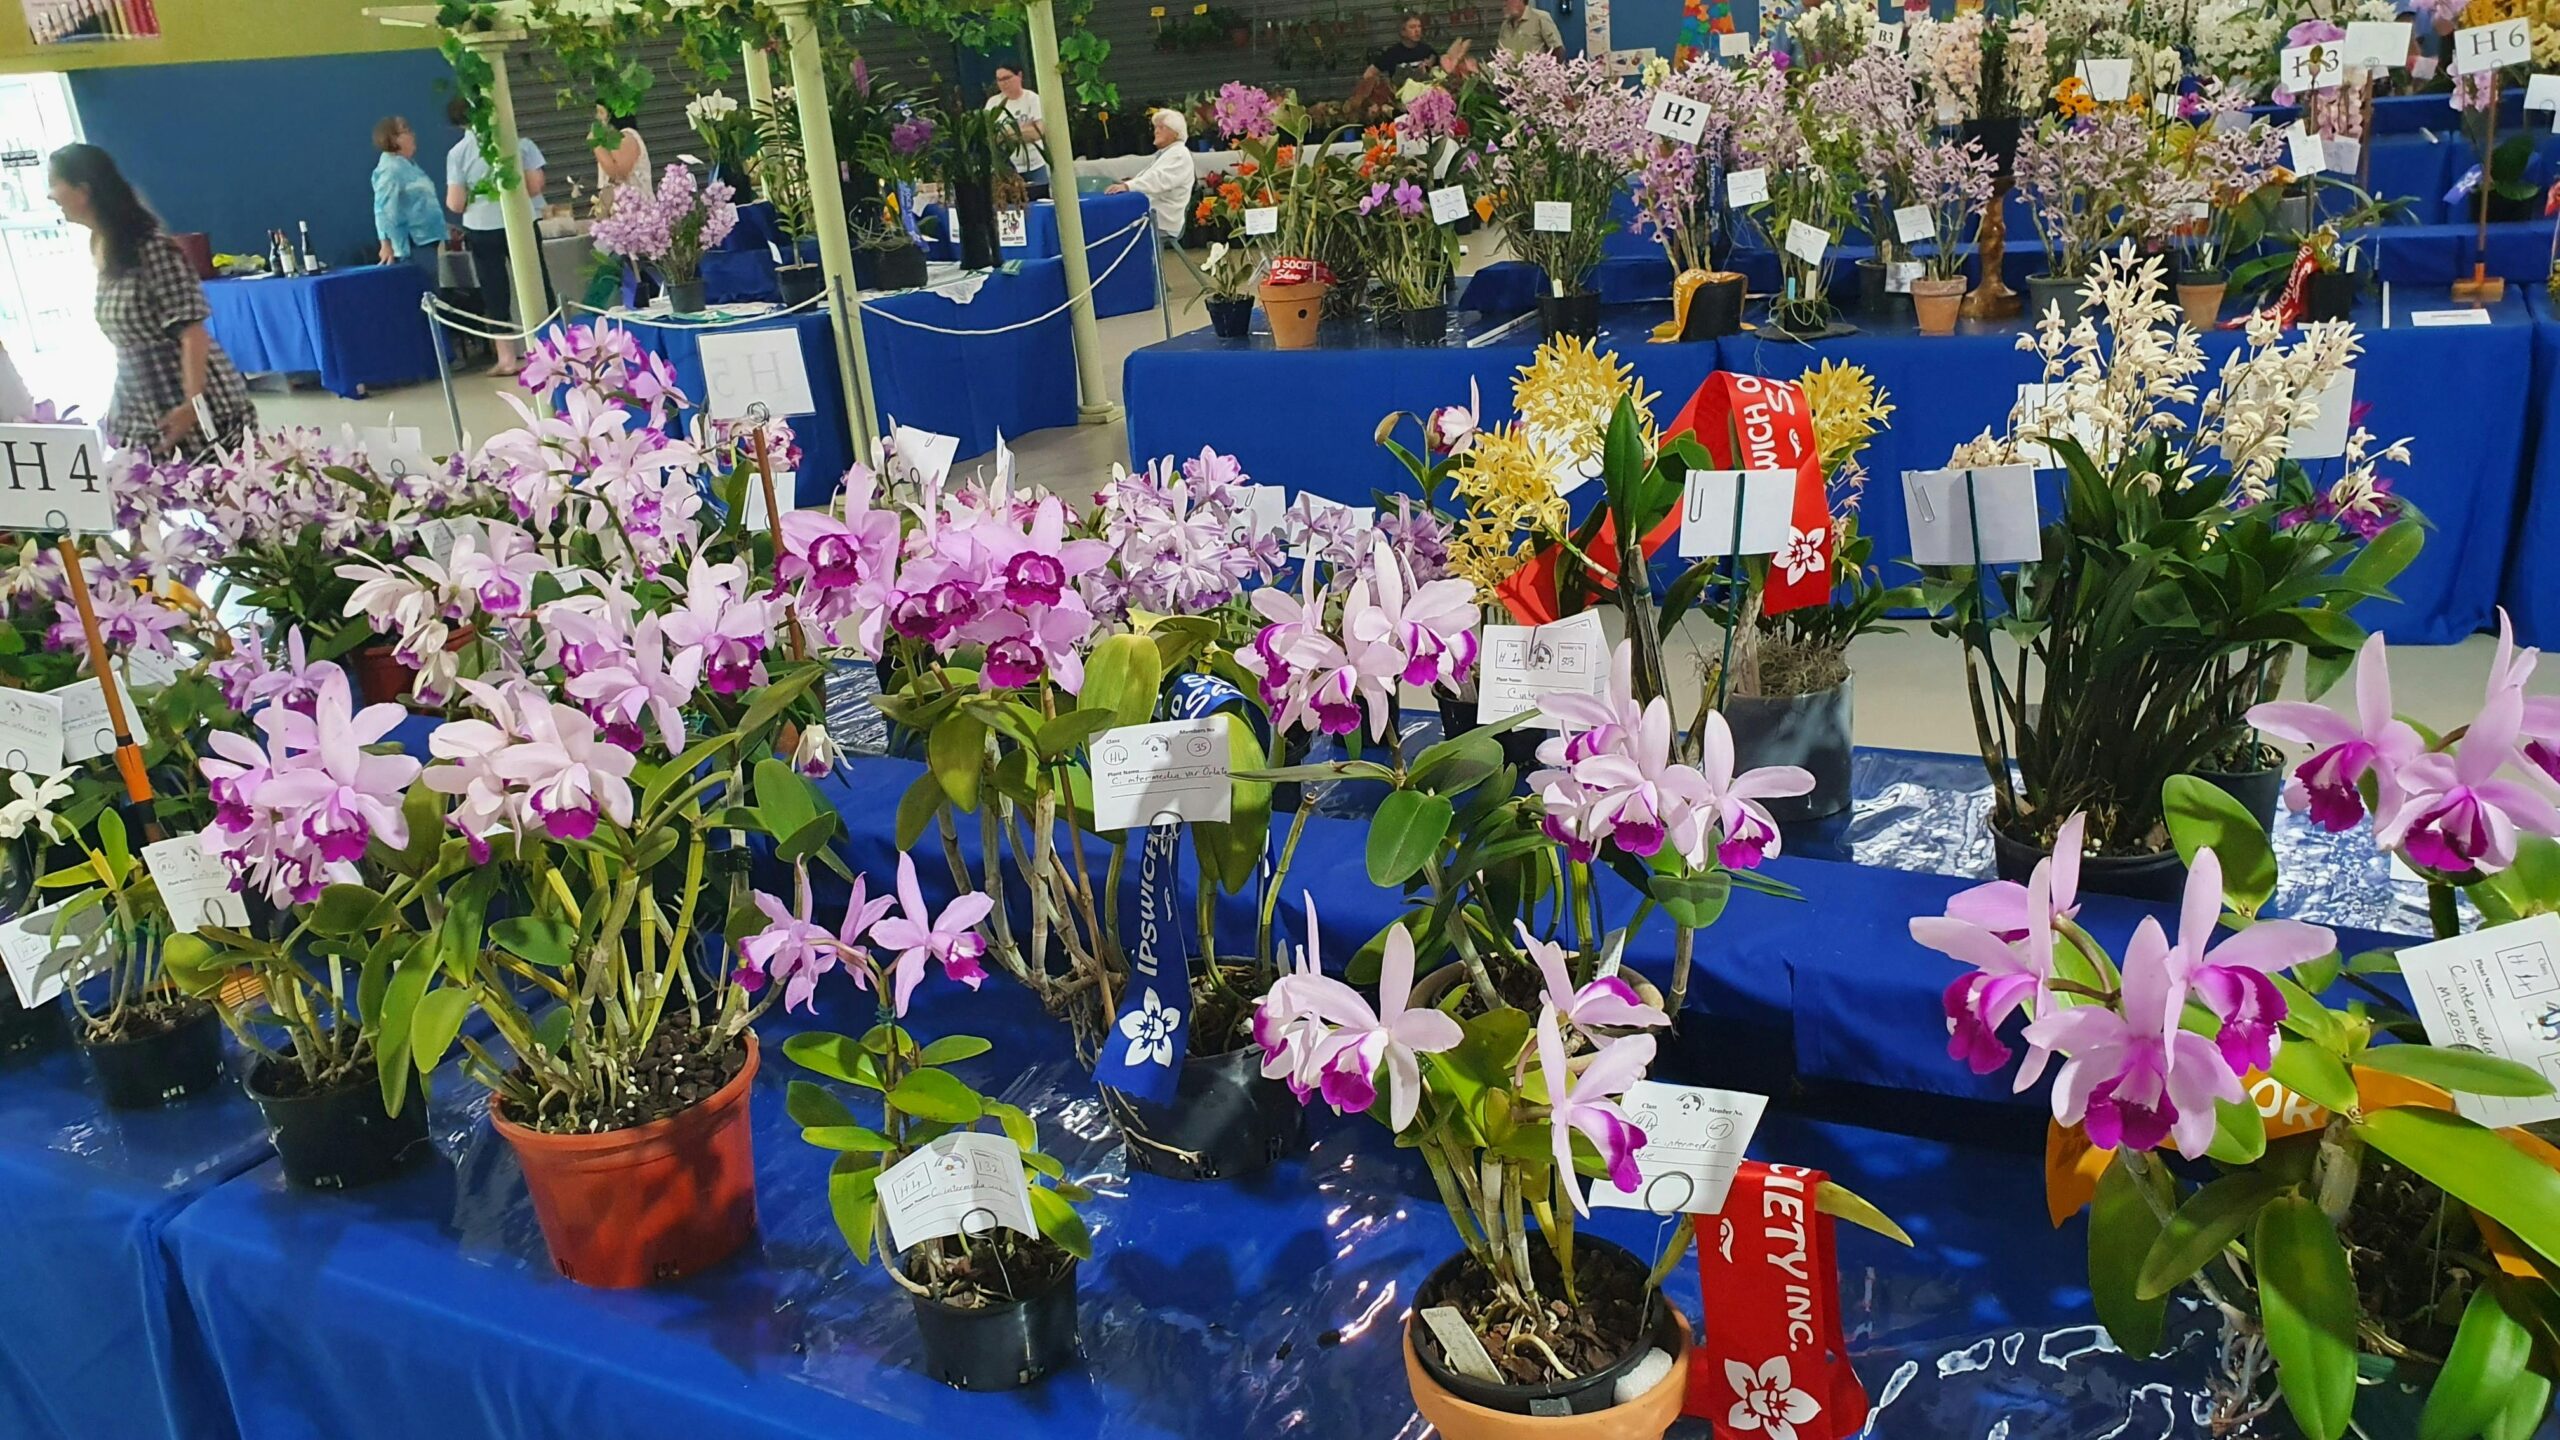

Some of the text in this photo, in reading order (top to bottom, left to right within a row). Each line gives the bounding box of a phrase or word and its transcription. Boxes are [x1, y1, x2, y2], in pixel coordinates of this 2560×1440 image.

[1878, 30, 1894, 43] B3
[1662, 101, 1696, 127] H2
[1743, 402, 1780, 471] WICH
[1194, 742, 1208, 752] 35
[1137, 833, 1159, 977] IPSWICH
[1641, 1102, 1657, 1110] Class
[1708, 1107, 1732, 1115] Member
[2249, 1077, 2319, 1128] OR
[1665, 1139, 1717, 1151] intermedia
[1763, 1163, 1814, 1352] CIETY INC.
